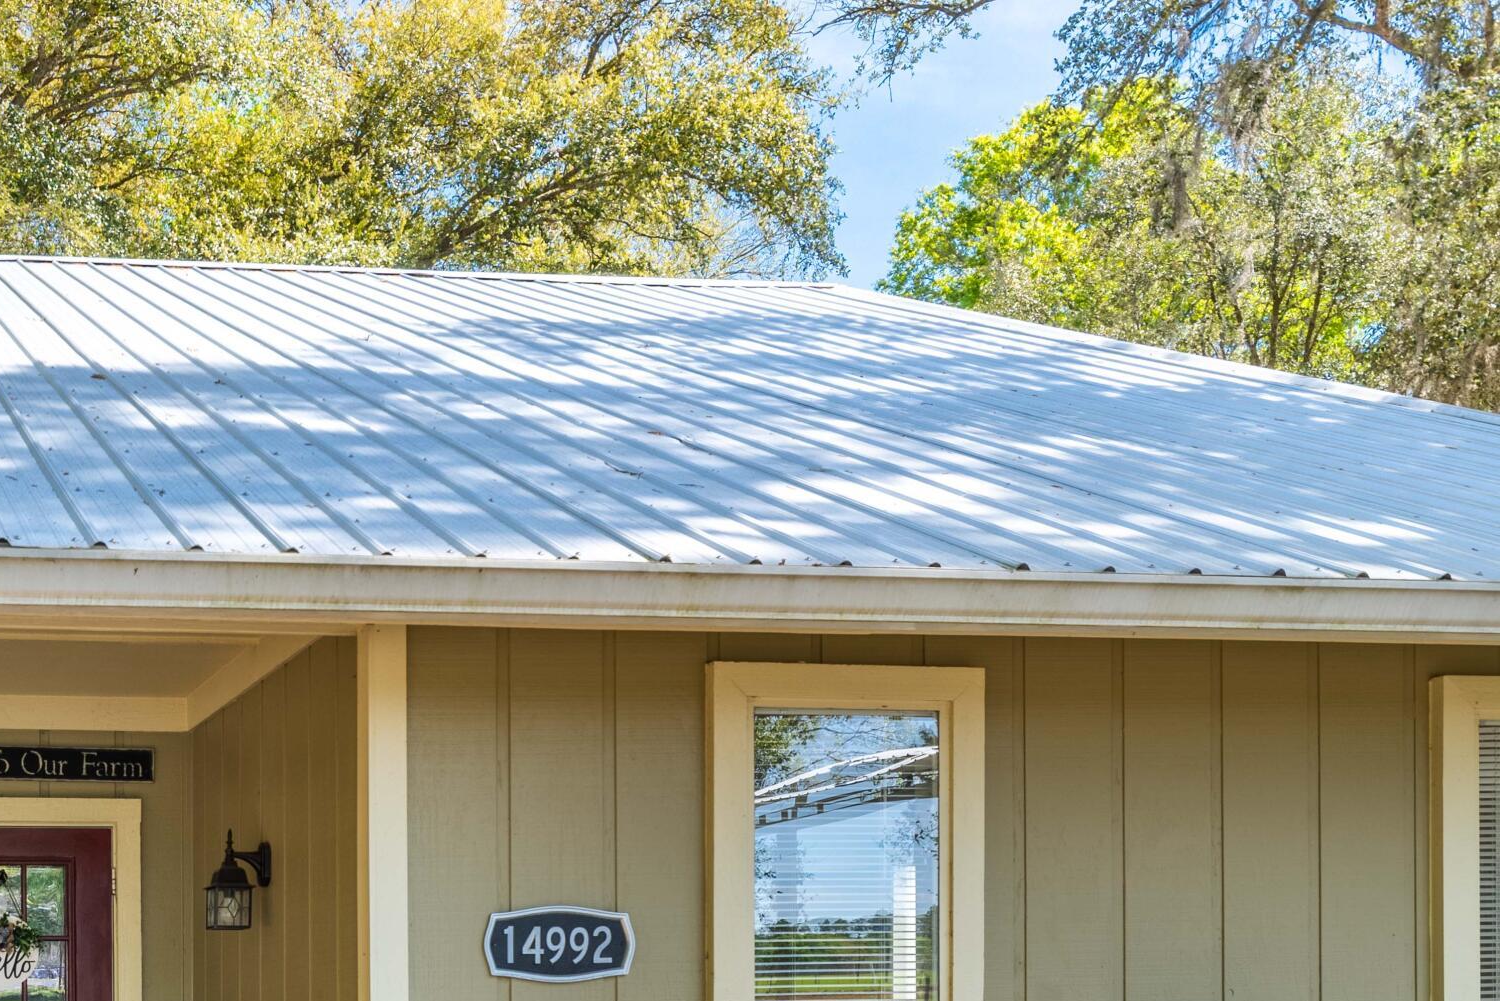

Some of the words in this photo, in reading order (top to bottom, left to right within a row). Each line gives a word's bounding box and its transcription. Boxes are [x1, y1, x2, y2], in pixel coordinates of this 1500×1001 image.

[21, 750, 68, 776] Our
[81, 751, 143, 777] Farm
[503, 925, 613, 965] 14992
